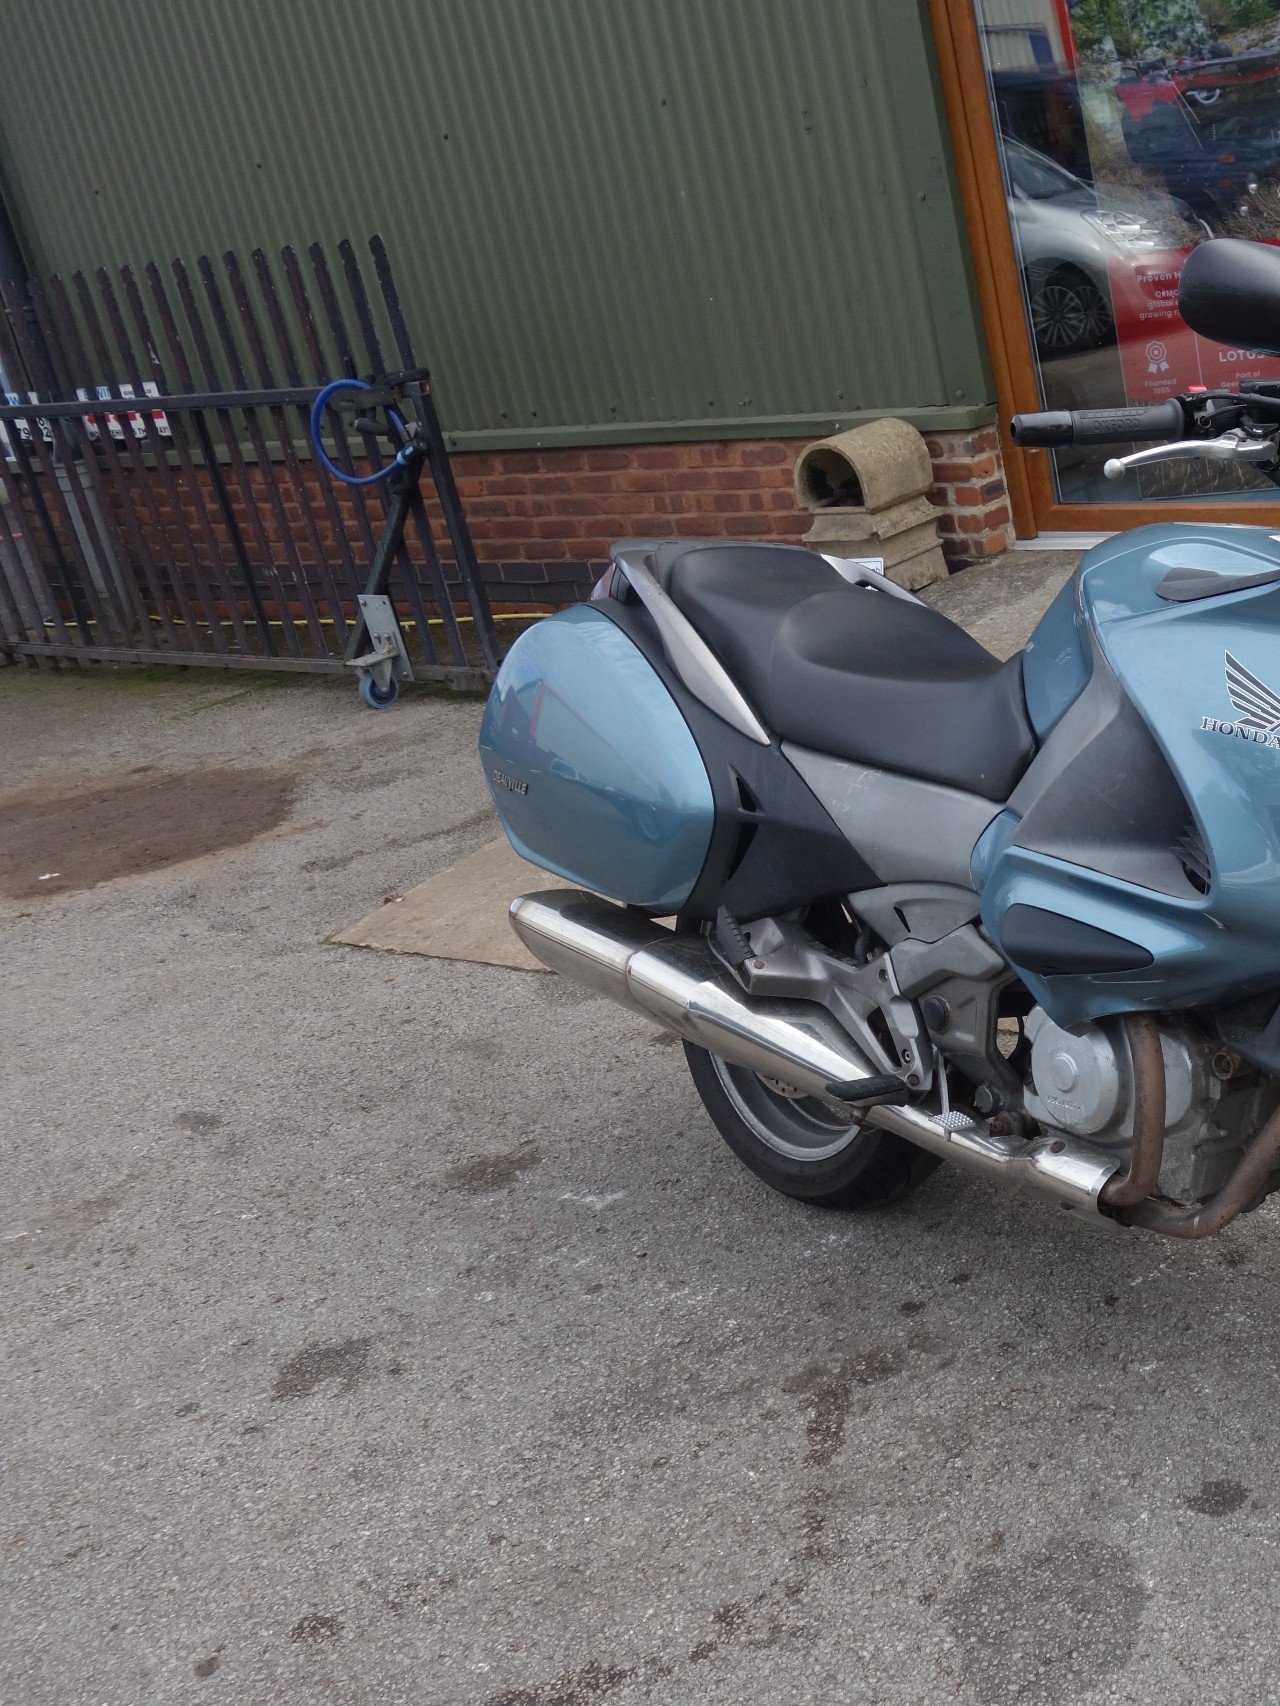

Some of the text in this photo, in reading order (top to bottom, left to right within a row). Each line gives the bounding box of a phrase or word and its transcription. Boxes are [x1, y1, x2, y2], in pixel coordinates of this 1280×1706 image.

[1137, 272, 1172, 283] Proven
[1147, 299, 1174, 310] global
[1139, 309, 1173, 320] growing
[1235, 371, 1251, 379] Part
[1144, 377, 1177, 387] Founded
[492, 769, 529, 795] DEAUVILLE
